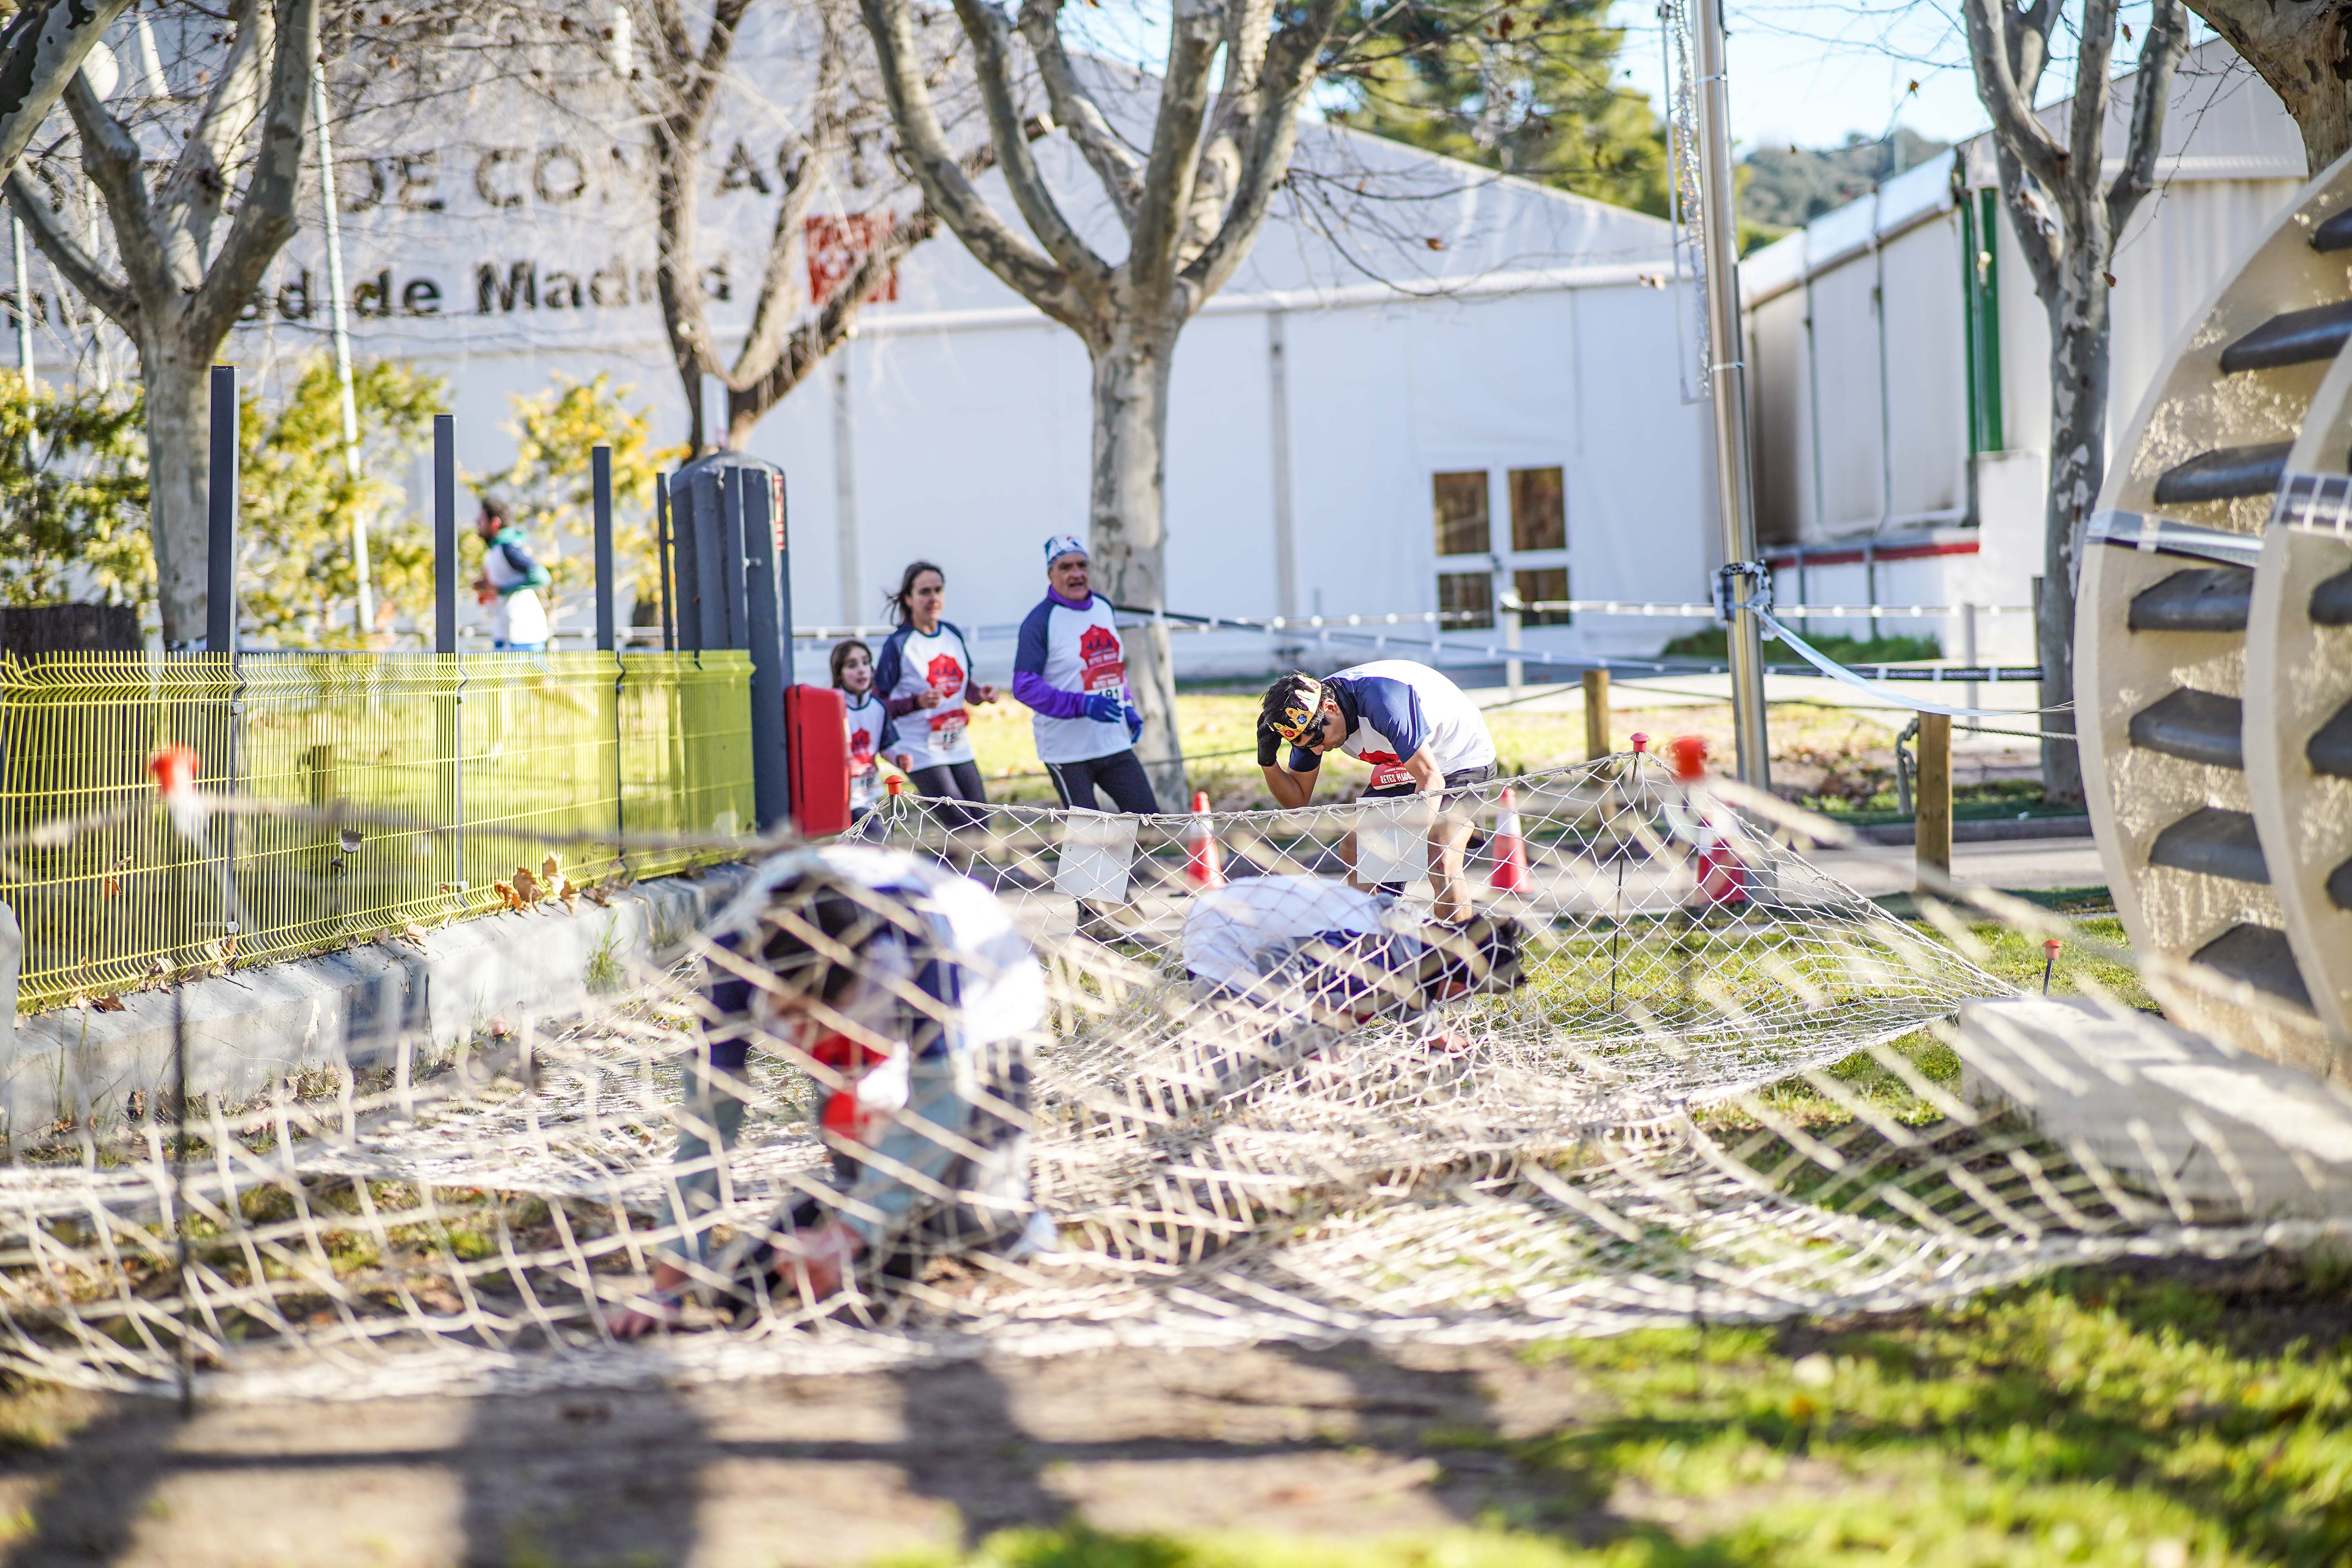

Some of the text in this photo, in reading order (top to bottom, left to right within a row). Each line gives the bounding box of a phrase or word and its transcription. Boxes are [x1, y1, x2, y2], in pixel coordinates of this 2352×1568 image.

[354, 269, 441, 316] de
[475, 253, 732, 313] Madrd
[1380, 774, 1396, 784] REYES
